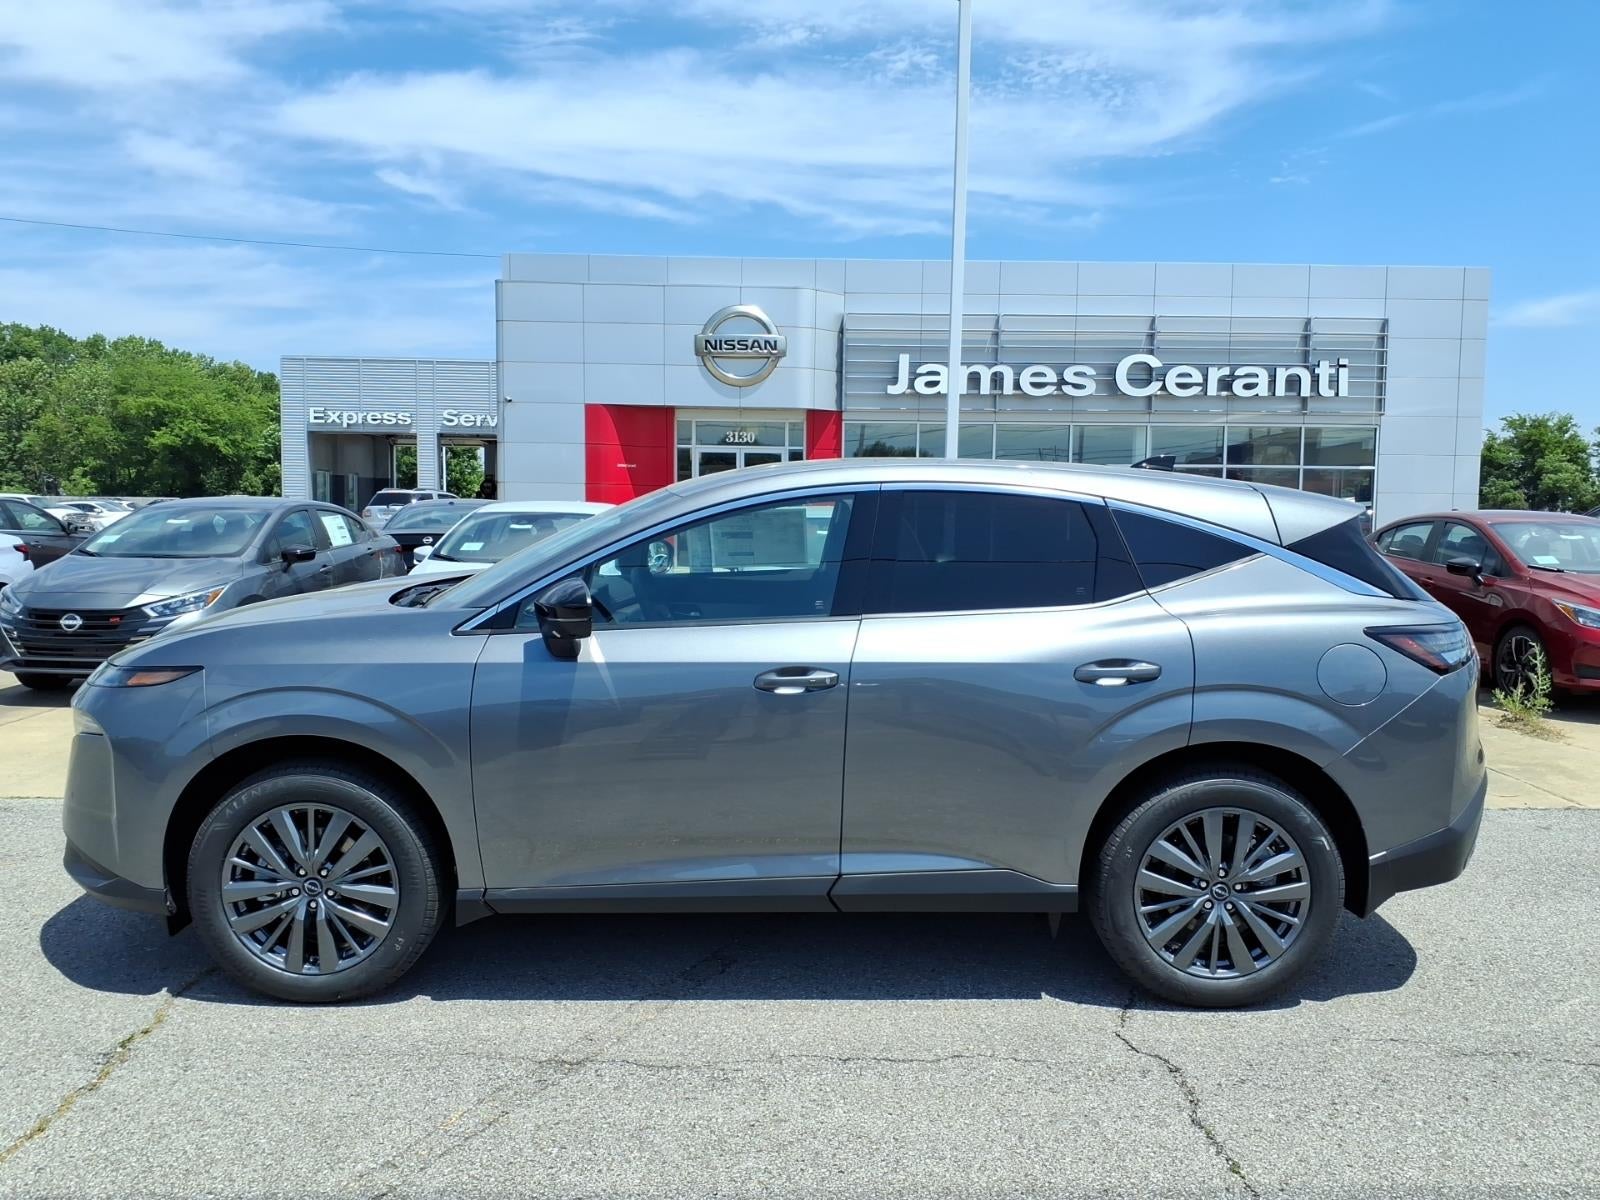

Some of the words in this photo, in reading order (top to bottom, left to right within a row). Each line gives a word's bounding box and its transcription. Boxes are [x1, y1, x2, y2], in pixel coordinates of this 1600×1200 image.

[704, 339, 779, 354] NISSAN
[886, 353, 1097, 397] James
[1115, 353, 1349, 398] Ceranti
[308, 407, 412, 427] Express
[441, 408, 497, 428] Serv
[725, 430, 756, 443] 3130
